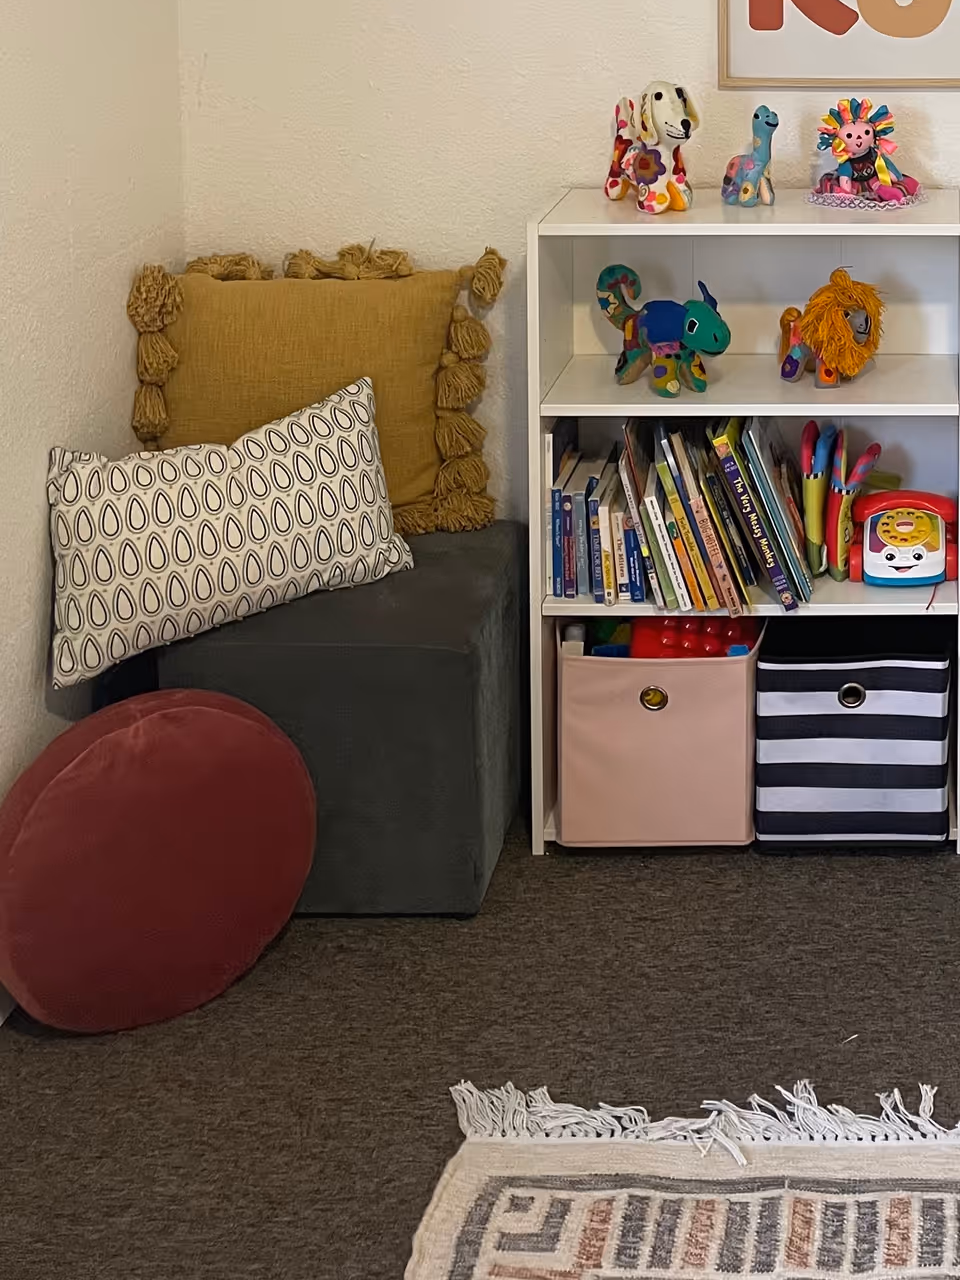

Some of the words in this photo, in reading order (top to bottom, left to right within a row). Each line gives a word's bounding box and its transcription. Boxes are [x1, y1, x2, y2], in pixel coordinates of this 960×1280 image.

[592, 533, 600, 551] TIME
[698, 518, 710, 534] BUG
[704, 533, 720, 558] HOTEL
[733, 477, 744, 493] The
[740, 493, 751, 513] Very
[747, 512, 763, 538] Messy
[759, 538, 776, 568] Monkey
